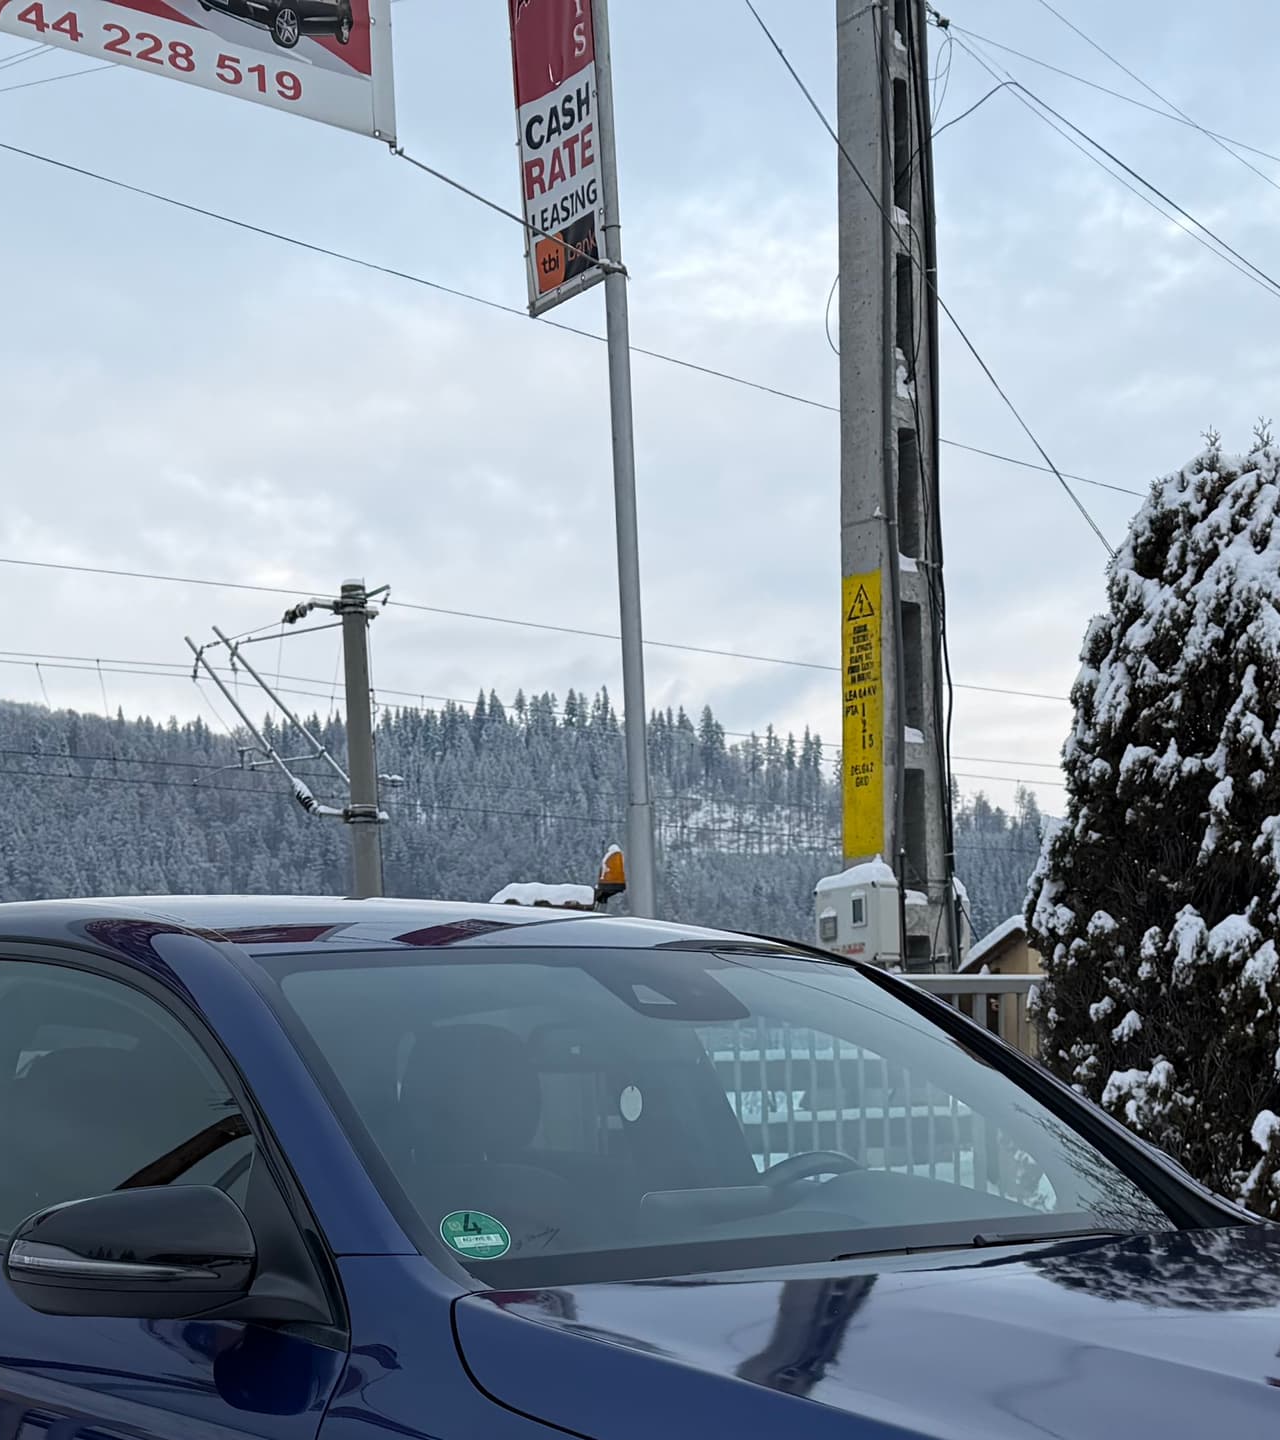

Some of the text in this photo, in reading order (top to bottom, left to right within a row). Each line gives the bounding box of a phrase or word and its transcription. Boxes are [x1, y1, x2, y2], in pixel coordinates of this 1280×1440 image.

[103, 23, 196, 73] 228
[216, 53, 303, 101] 519
[525, 82, 591, 150] CASH
[524, 122, 595, 201] RATE
[531, 178, 598, 238] LEASING
[542, 249, 560, 274] tbi
[464, 1213, 482, 1234] 4
